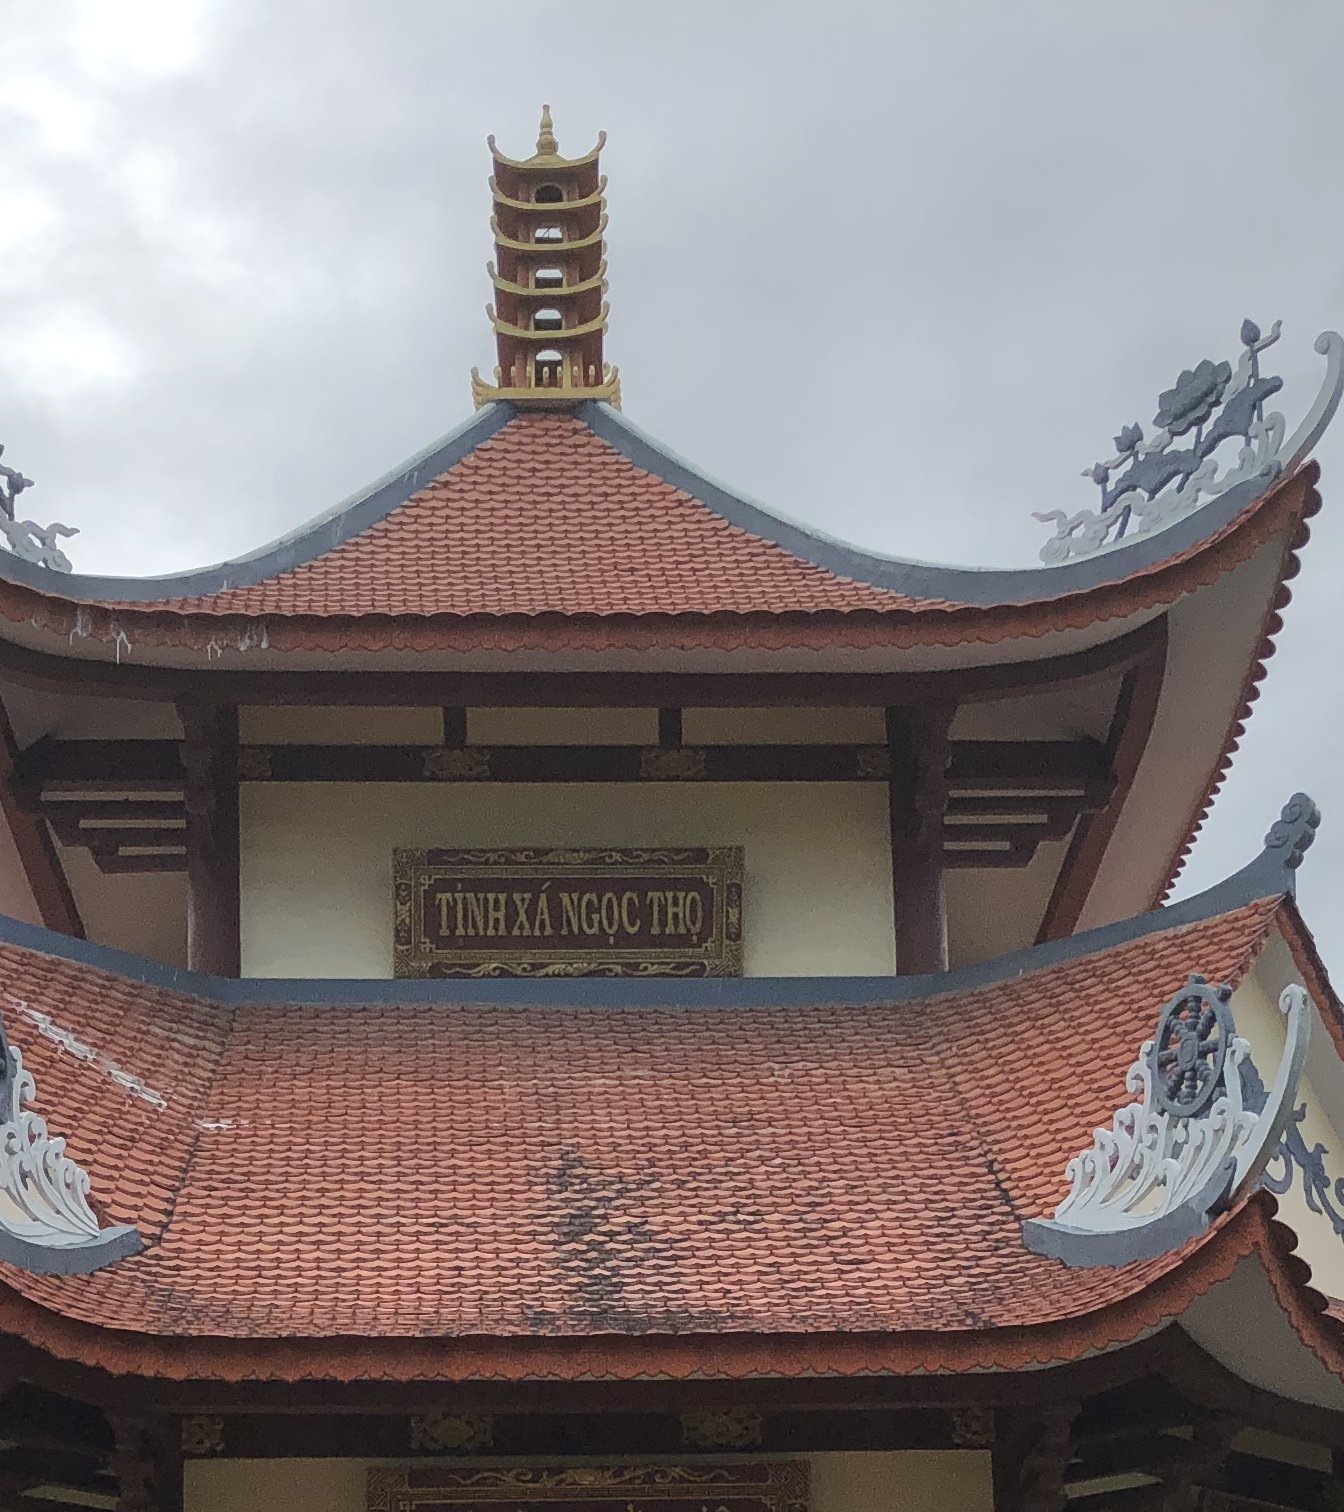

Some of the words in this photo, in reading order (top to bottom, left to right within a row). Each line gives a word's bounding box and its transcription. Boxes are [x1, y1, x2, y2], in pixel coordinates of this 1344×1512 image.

[512, 881, 553, 937] XÁ
[560, 891, 640, 945] NGỌC
[646, 891, 704, 944] THỌ
